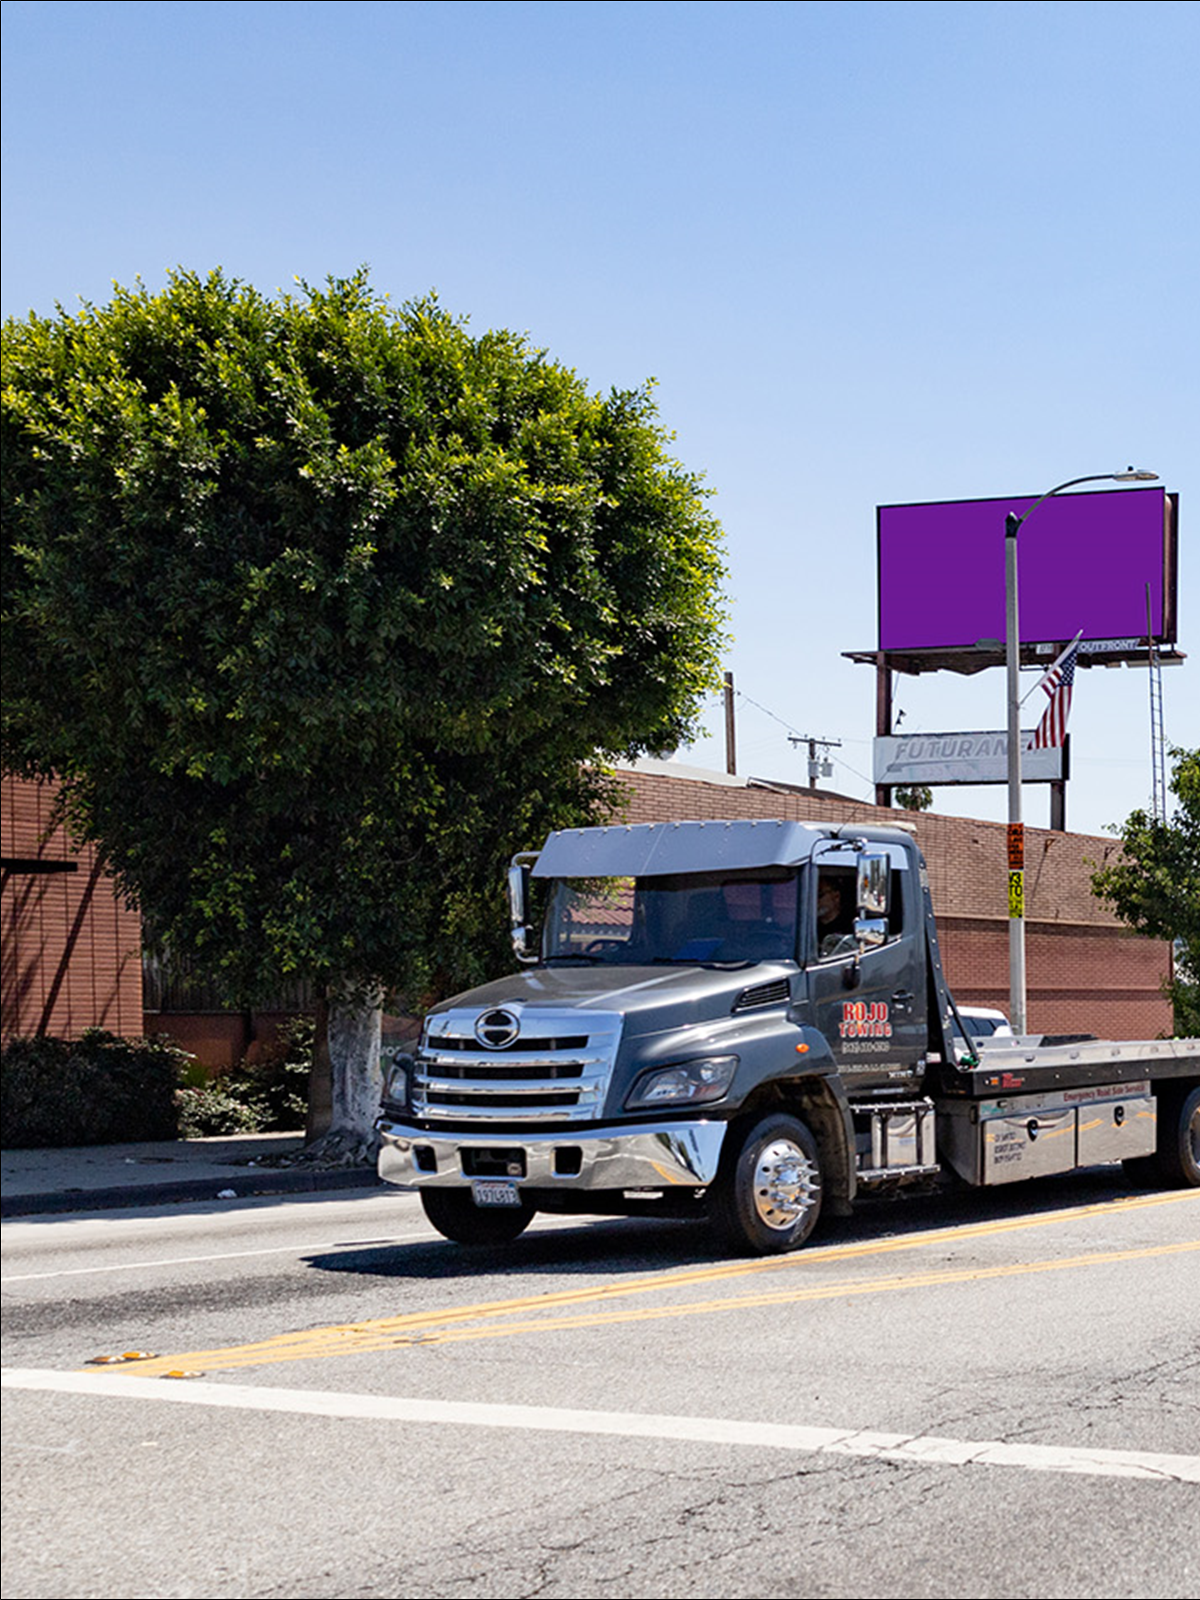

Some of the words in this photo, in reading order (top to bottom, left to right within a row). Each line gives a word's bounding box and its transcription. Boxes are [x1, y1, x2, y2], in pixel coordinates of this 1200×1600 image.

[1079, 640, 1137, 652] OUTFRONT
[843, 1001, 888, 1023] ROJO
[839, 1022, 893, 1038] TOWING
[1063, 1091, 1095, 1102] Emergency
[1096, 1088, 1110, 1097] Road
[1112, 1085, 1124, 1095] Side
[1125, 1083, 1145, 1093] Service
